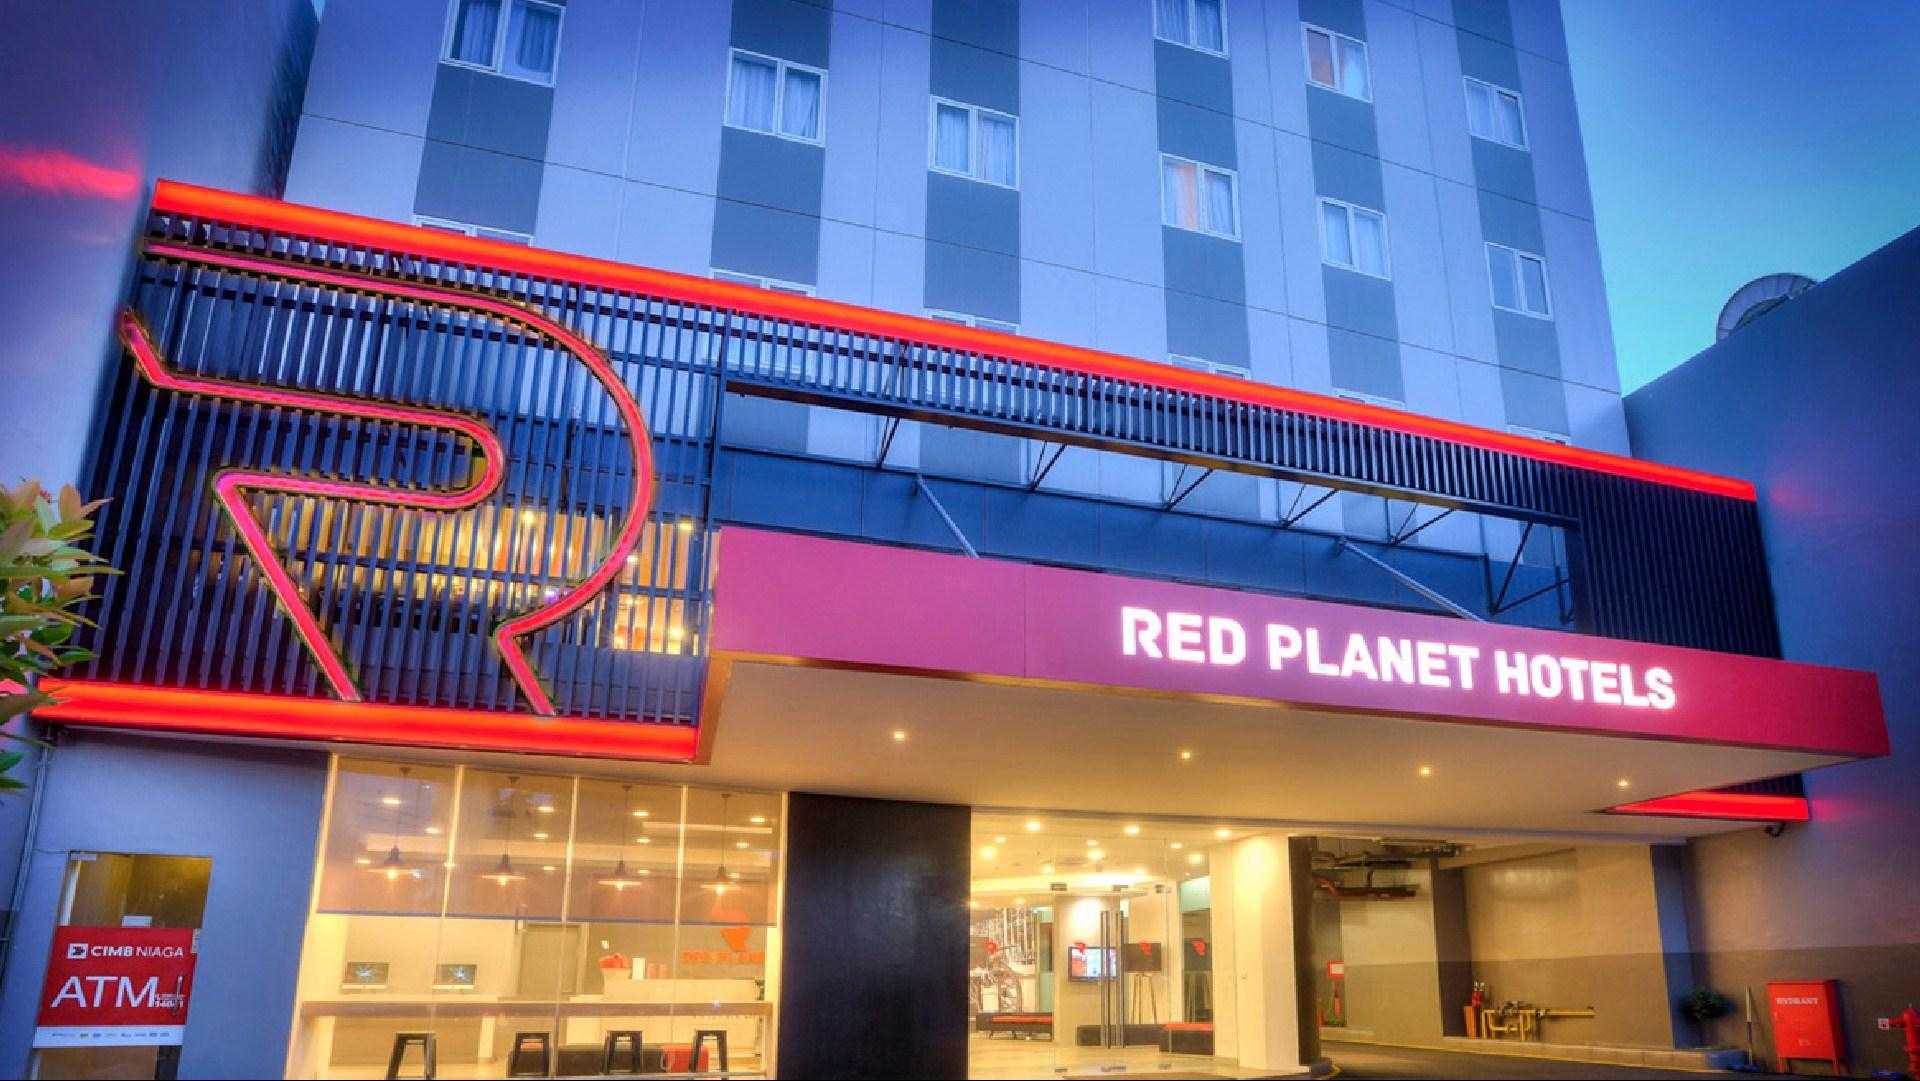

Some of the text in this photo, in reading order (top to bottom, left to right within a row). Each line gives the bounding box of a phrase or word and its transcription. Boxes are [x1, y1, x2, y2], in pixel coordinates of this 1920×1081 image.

[1121, 606, 1677, 710] RED PLANET HOTELS
[91, 945, 184, 958] CIMB NIAGA
[51, 976, 159, 1008] ATM
